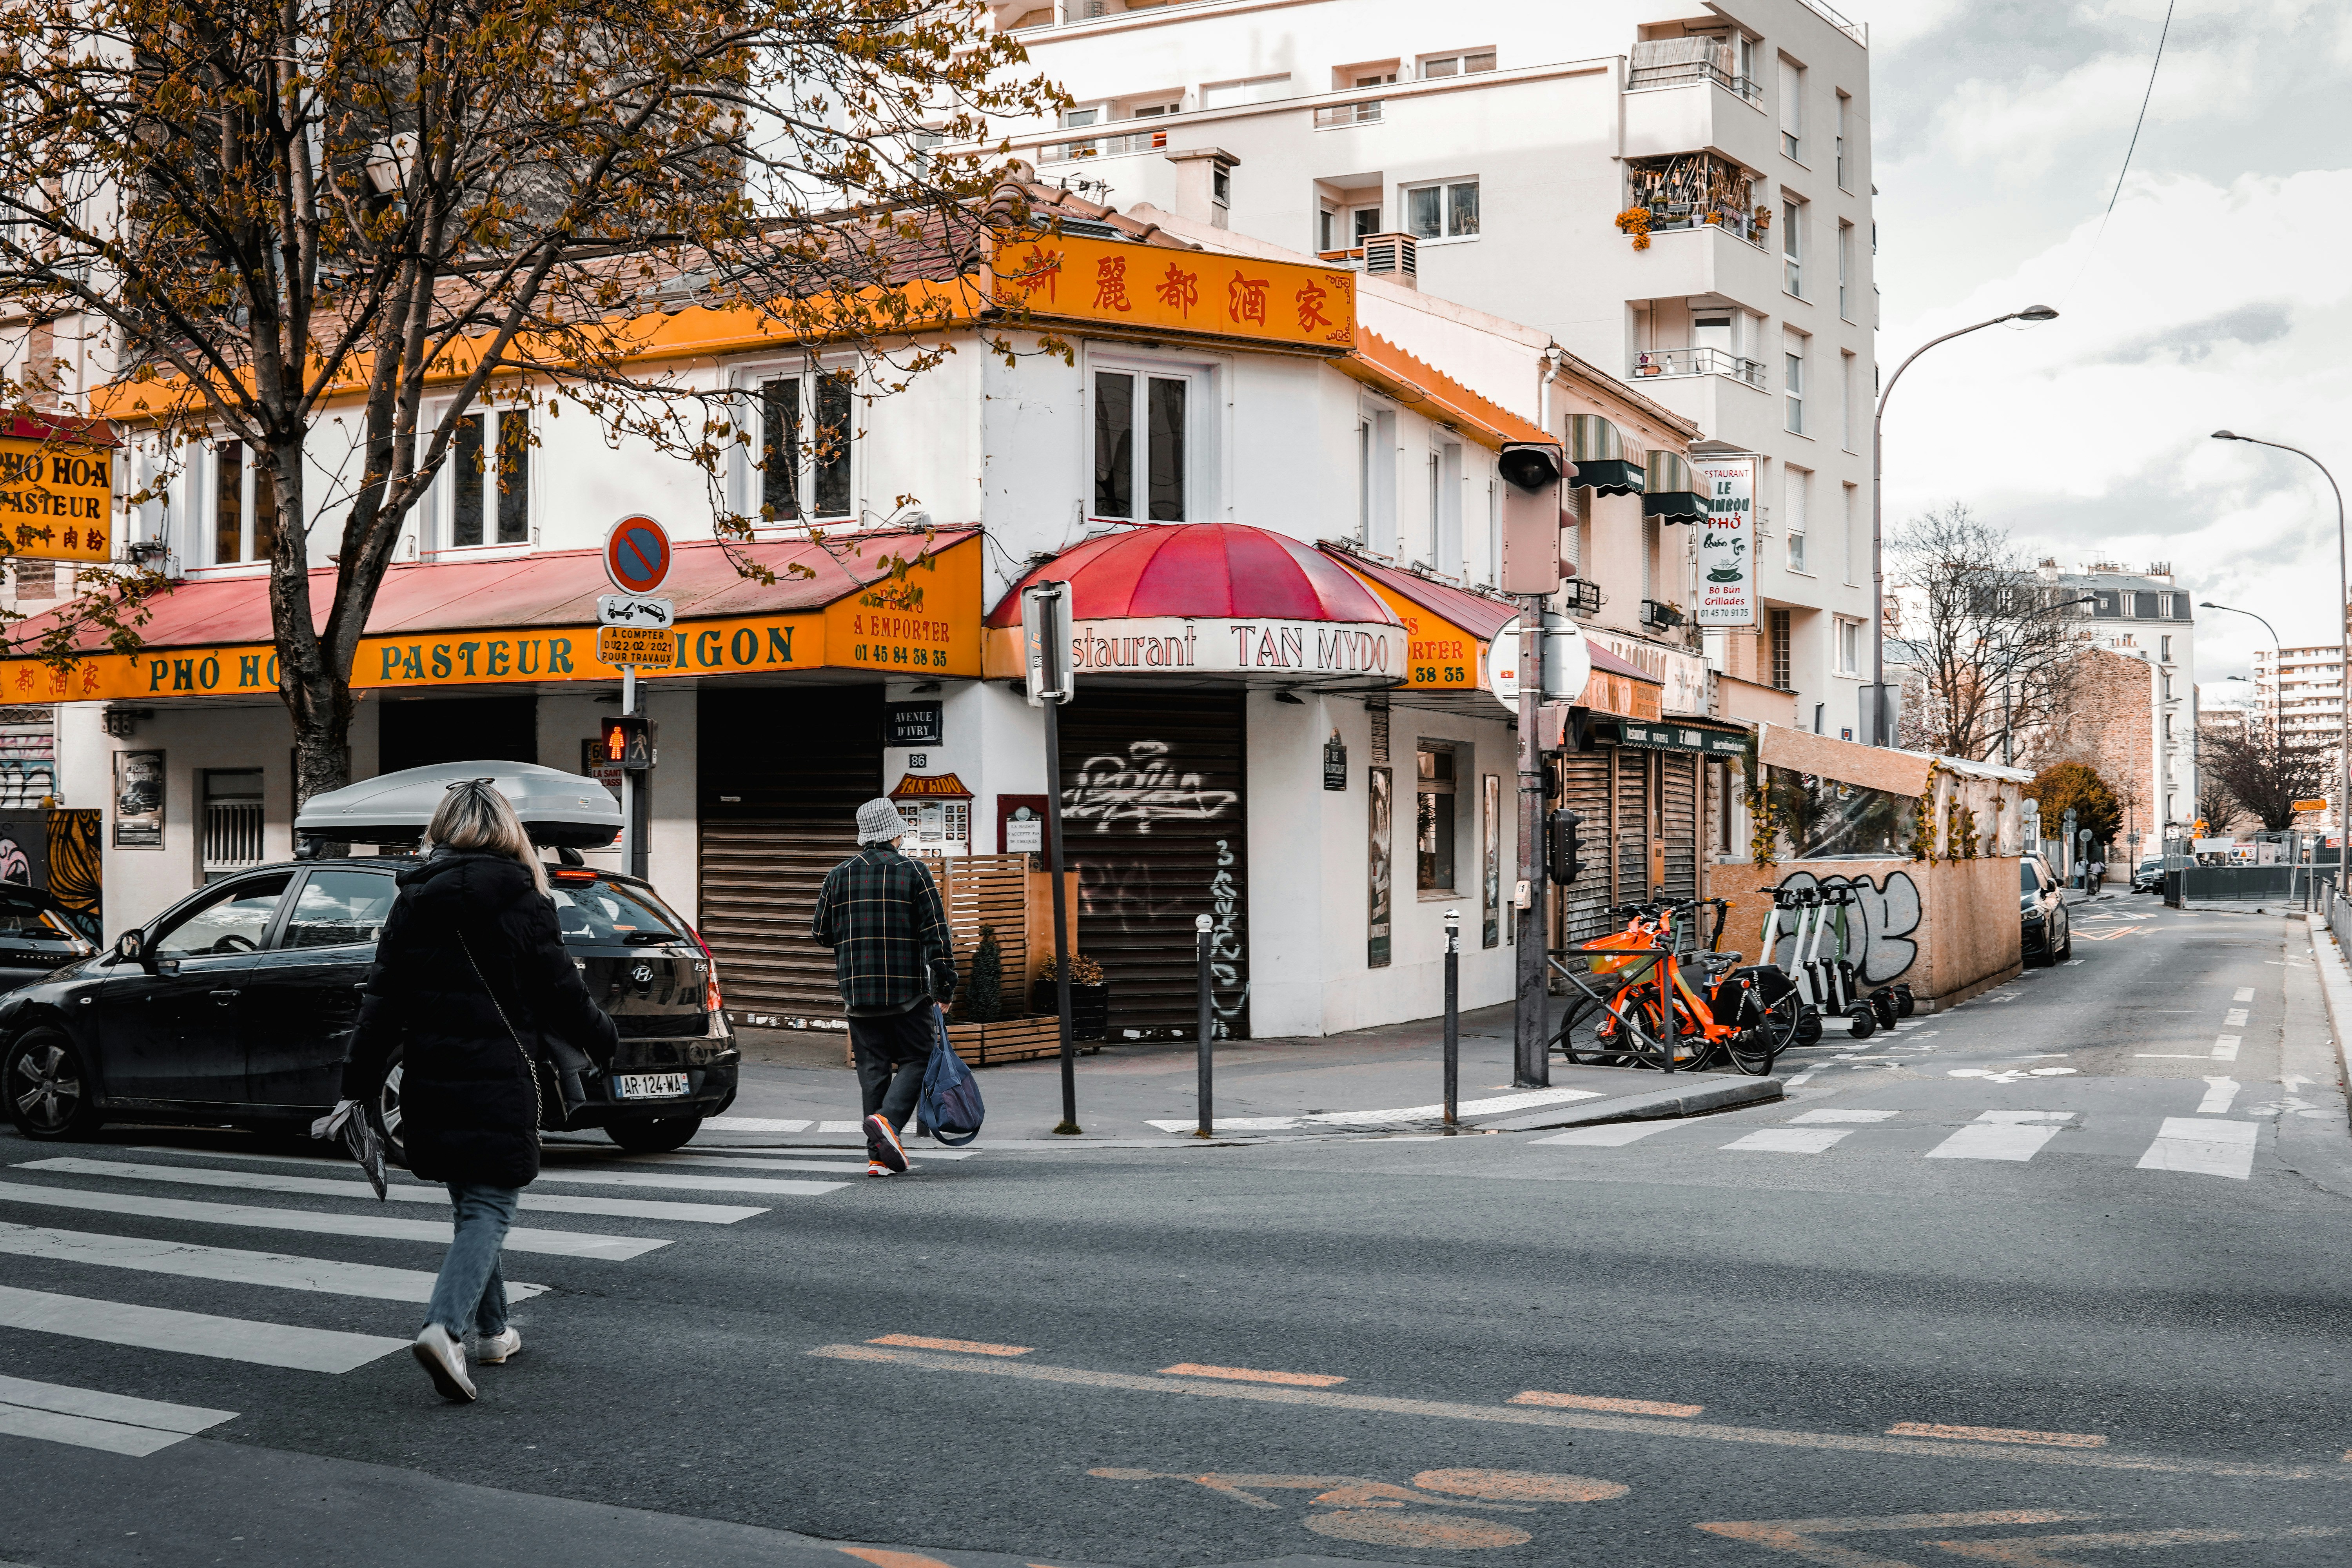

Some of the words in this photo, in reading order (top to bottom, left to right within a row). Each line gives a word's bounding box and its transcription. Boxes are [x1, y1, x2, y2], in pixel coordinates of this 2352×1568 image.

[0, 451, 43, 482] HO
[52, 457, 109, 488] HOA
[1717, 481, 1731, 494] LE
[0, 491, 100, 519] ASTEUR
[1708, 498, 1749, 512] AMBOU
[0, 523, 106, 551] 牛肉粉
[1709, 585, 1720, 593] Bò
[1723, 585, 1740, 593] Bún
[880, 589, 924, 613] PLS
[612, 628, 617, 638] À
[622, 630, 664, 640] COMPTER
[854, 614, 863, 634] A
[871, 615, 949, 642] EMPORTER
[381, 638, 574, 680] PASTEUR
[615, 626, 795, 671] IGON
[602, 652, 627, 661] POUR
[631, 653, 671, 662] TRAVAUX
[855, 643, 867, 661] 01
[873, 645, 887, 662] 45
[894, 646, 907, 663] 84
[914, 648, 927, 665] 38
[933, 650, 946, 666] 35
[1073, 626, 1196, 668] staurant
[1231, 626, 1302, 667] TAN
[1318, 629, 1388, 673] MYDO
[1408, 641, 1464, 659] RTER
[0, 661, 100, 699] 都酒家
[1416, 667, 1436, 682] 38
[1445, 666, 1465, 682] 35
[895, 712, 933, 722] AVENUE
[897, 726, 929, 736] D'IVRY
[911, 755, 925, 766] 86
[900, 778, 925, 793] TAN
